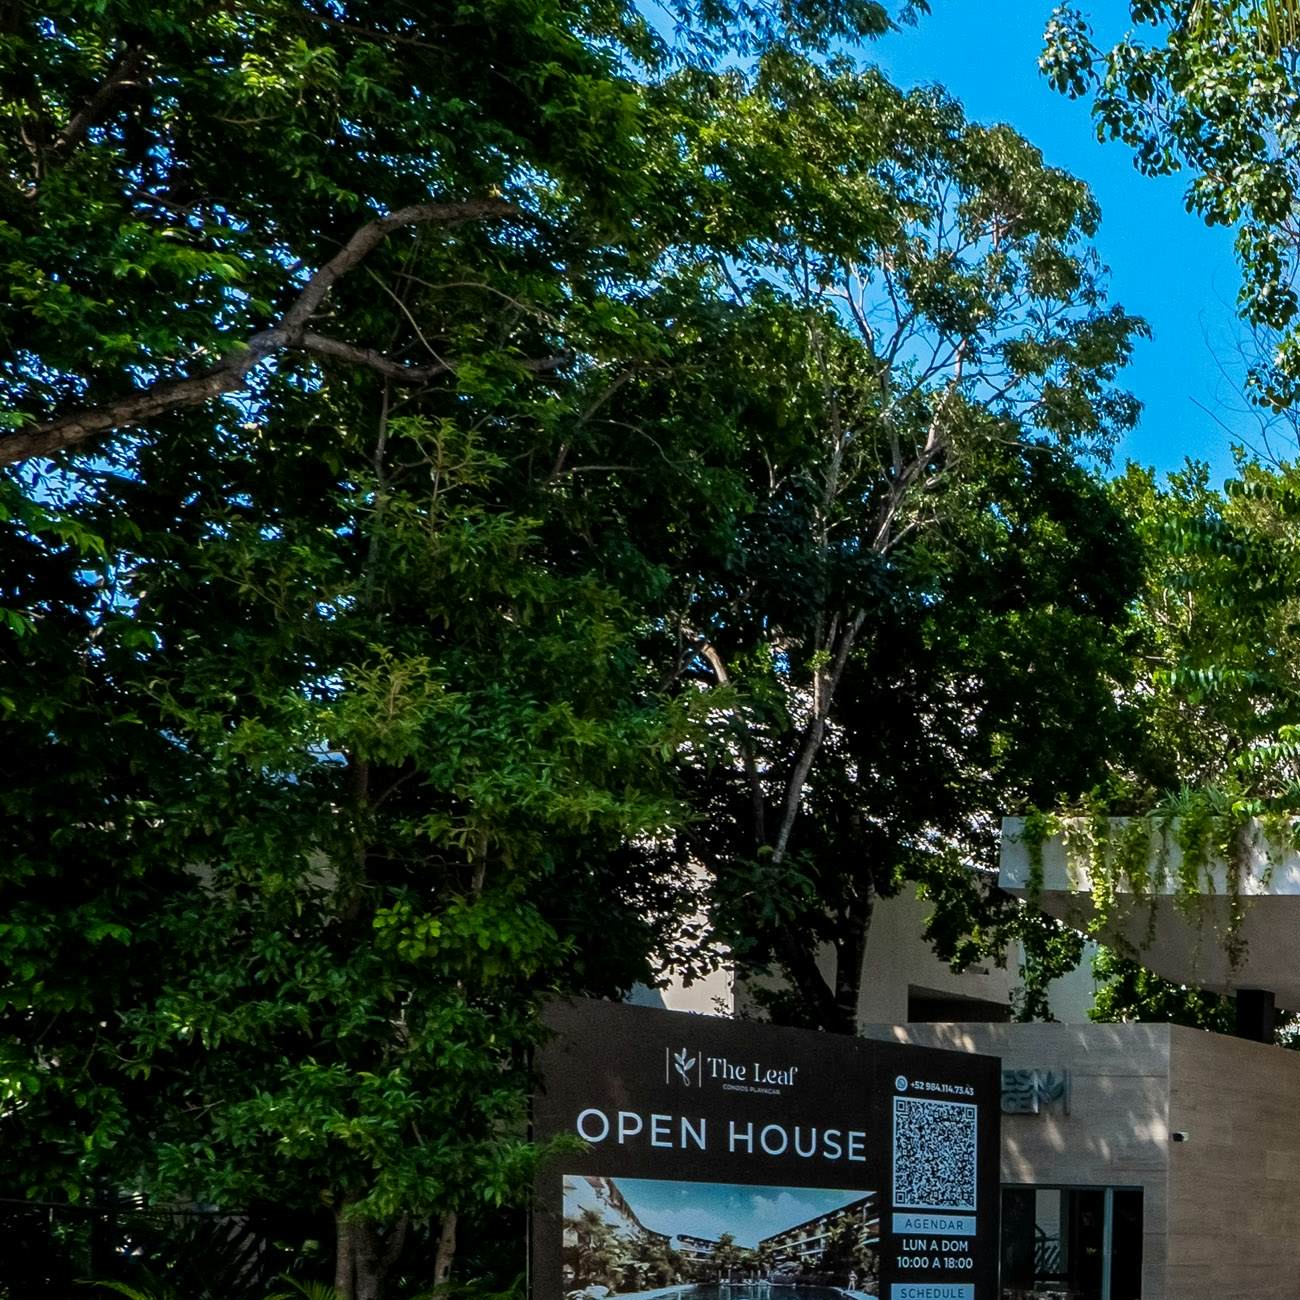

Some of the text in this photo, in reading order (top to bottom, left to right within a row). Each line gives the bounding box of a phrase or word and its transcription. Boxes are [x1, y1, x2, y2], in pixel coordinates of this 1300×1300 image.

[707, 1058, 798, 1086] The Leaf
[722, 1083, 781, 1095] CONDOS PLAYACAR
[911, 1080, 925, 1090] +52
[577, 1108, 866, 1162] OPEN HOUSE
[904, 1218, 964, 1230] AGENDAR
[902, 1239, 968, 1252] LUN A DOM
[896, 1256, 973, 1269] 10:00 A 18:00
[901, 1288, 965, 1299] SCHEDULE
